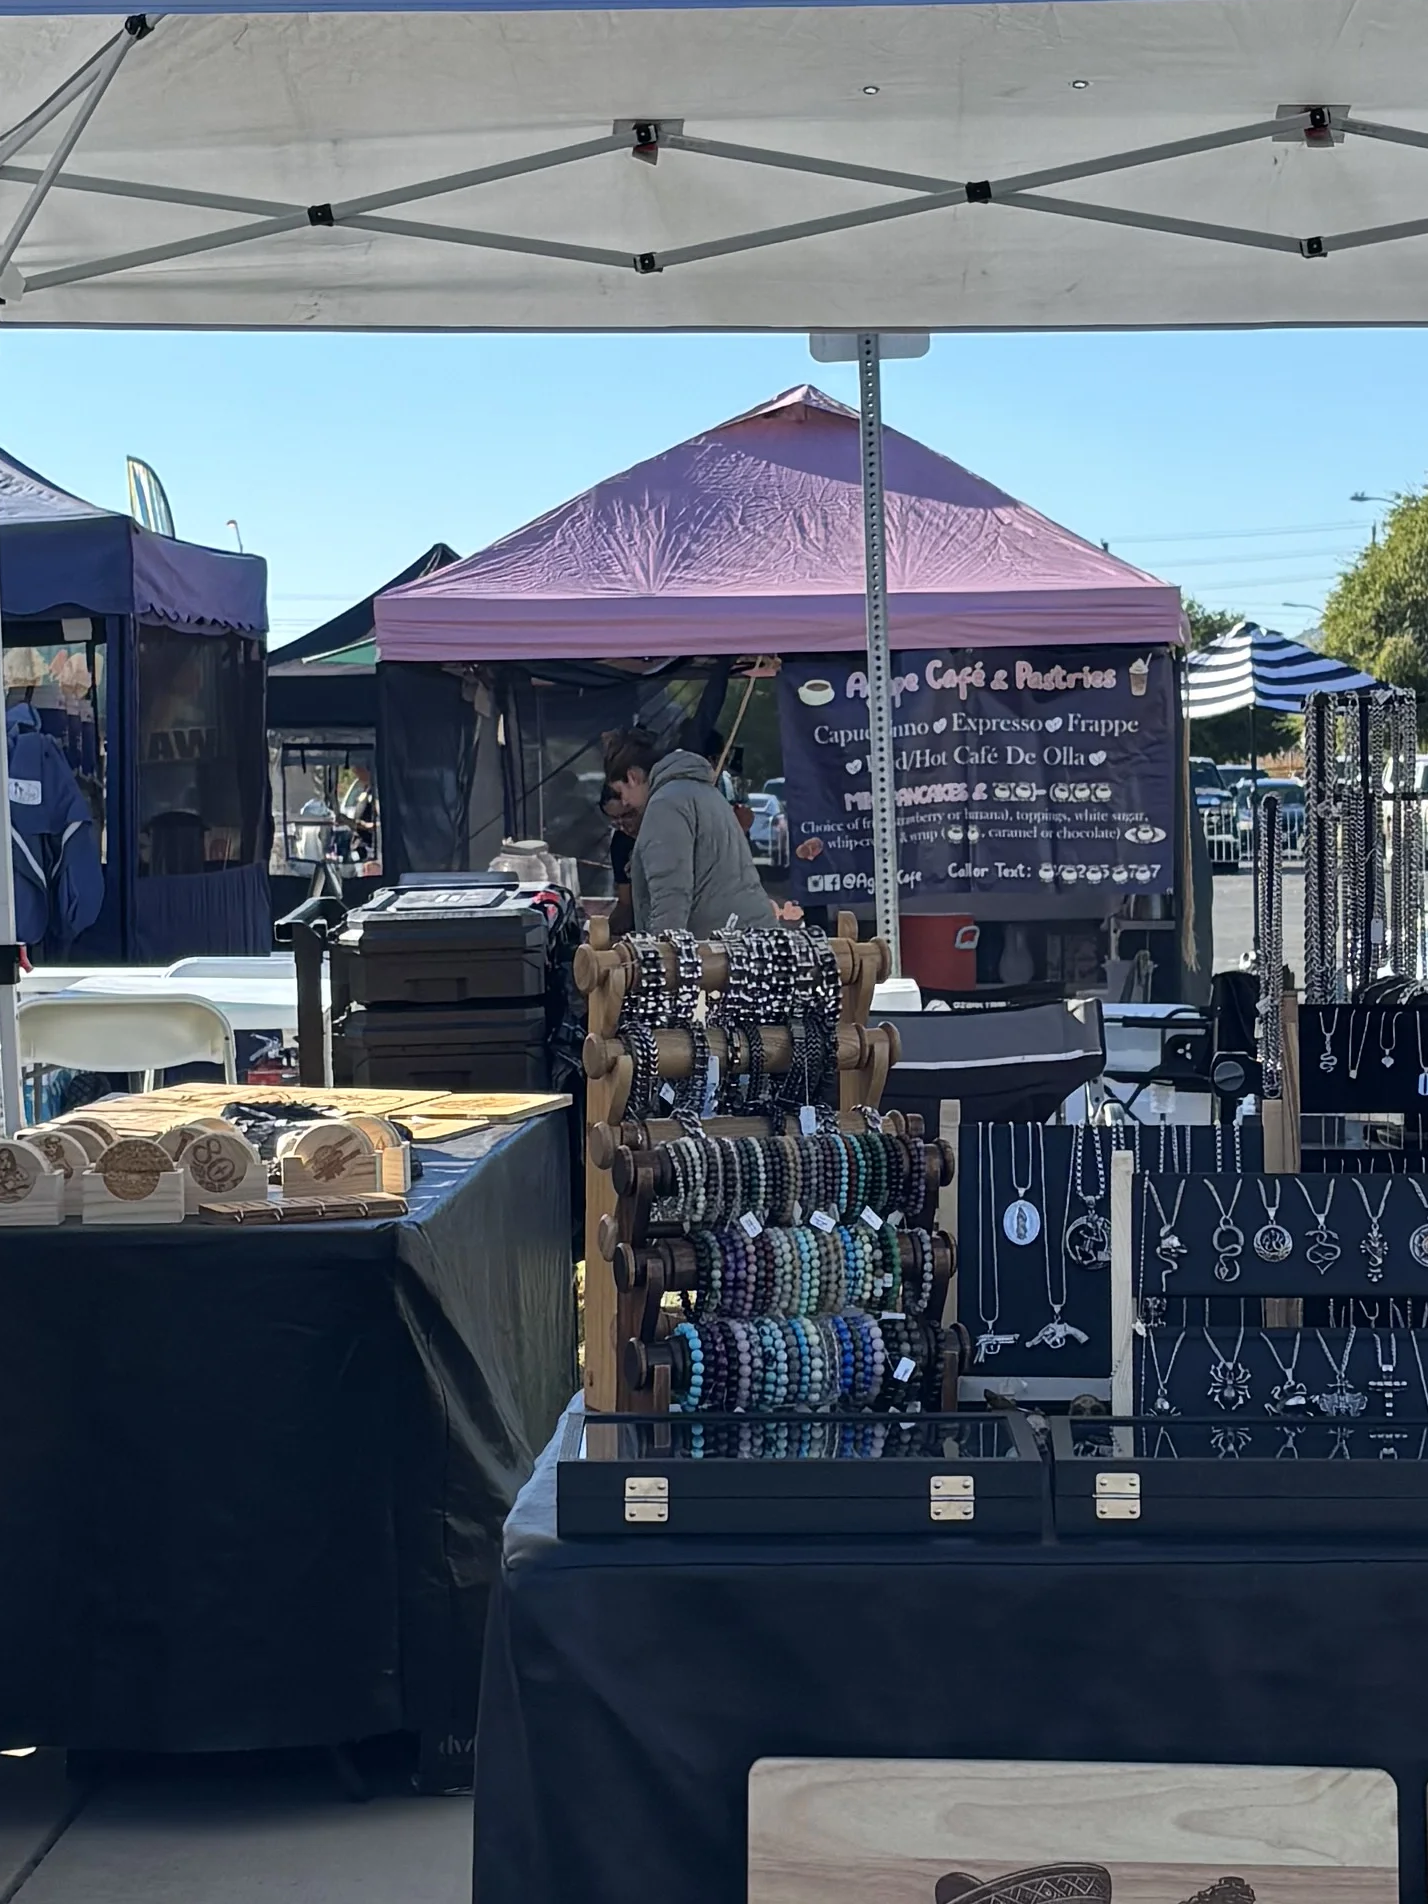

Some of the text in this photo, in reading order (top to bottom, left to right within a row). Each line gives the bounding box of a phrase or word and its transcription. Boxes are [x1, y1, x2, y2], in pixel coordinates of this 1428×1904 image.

[846, 659, 1117, 708] Ape Café & Pastries
[952, 712, 1043, 735] Expresso
[1067, 713, 1139, 736] Frappe
[866, 745, 1085, 773] Id/Hot Café De Olla
[895, 782, 969, 807] ANCAKES
[1074, 807, 1109, 822] white
[800, 820, 845, 834] Choice
[994, 862, 1032, 878] Text:
